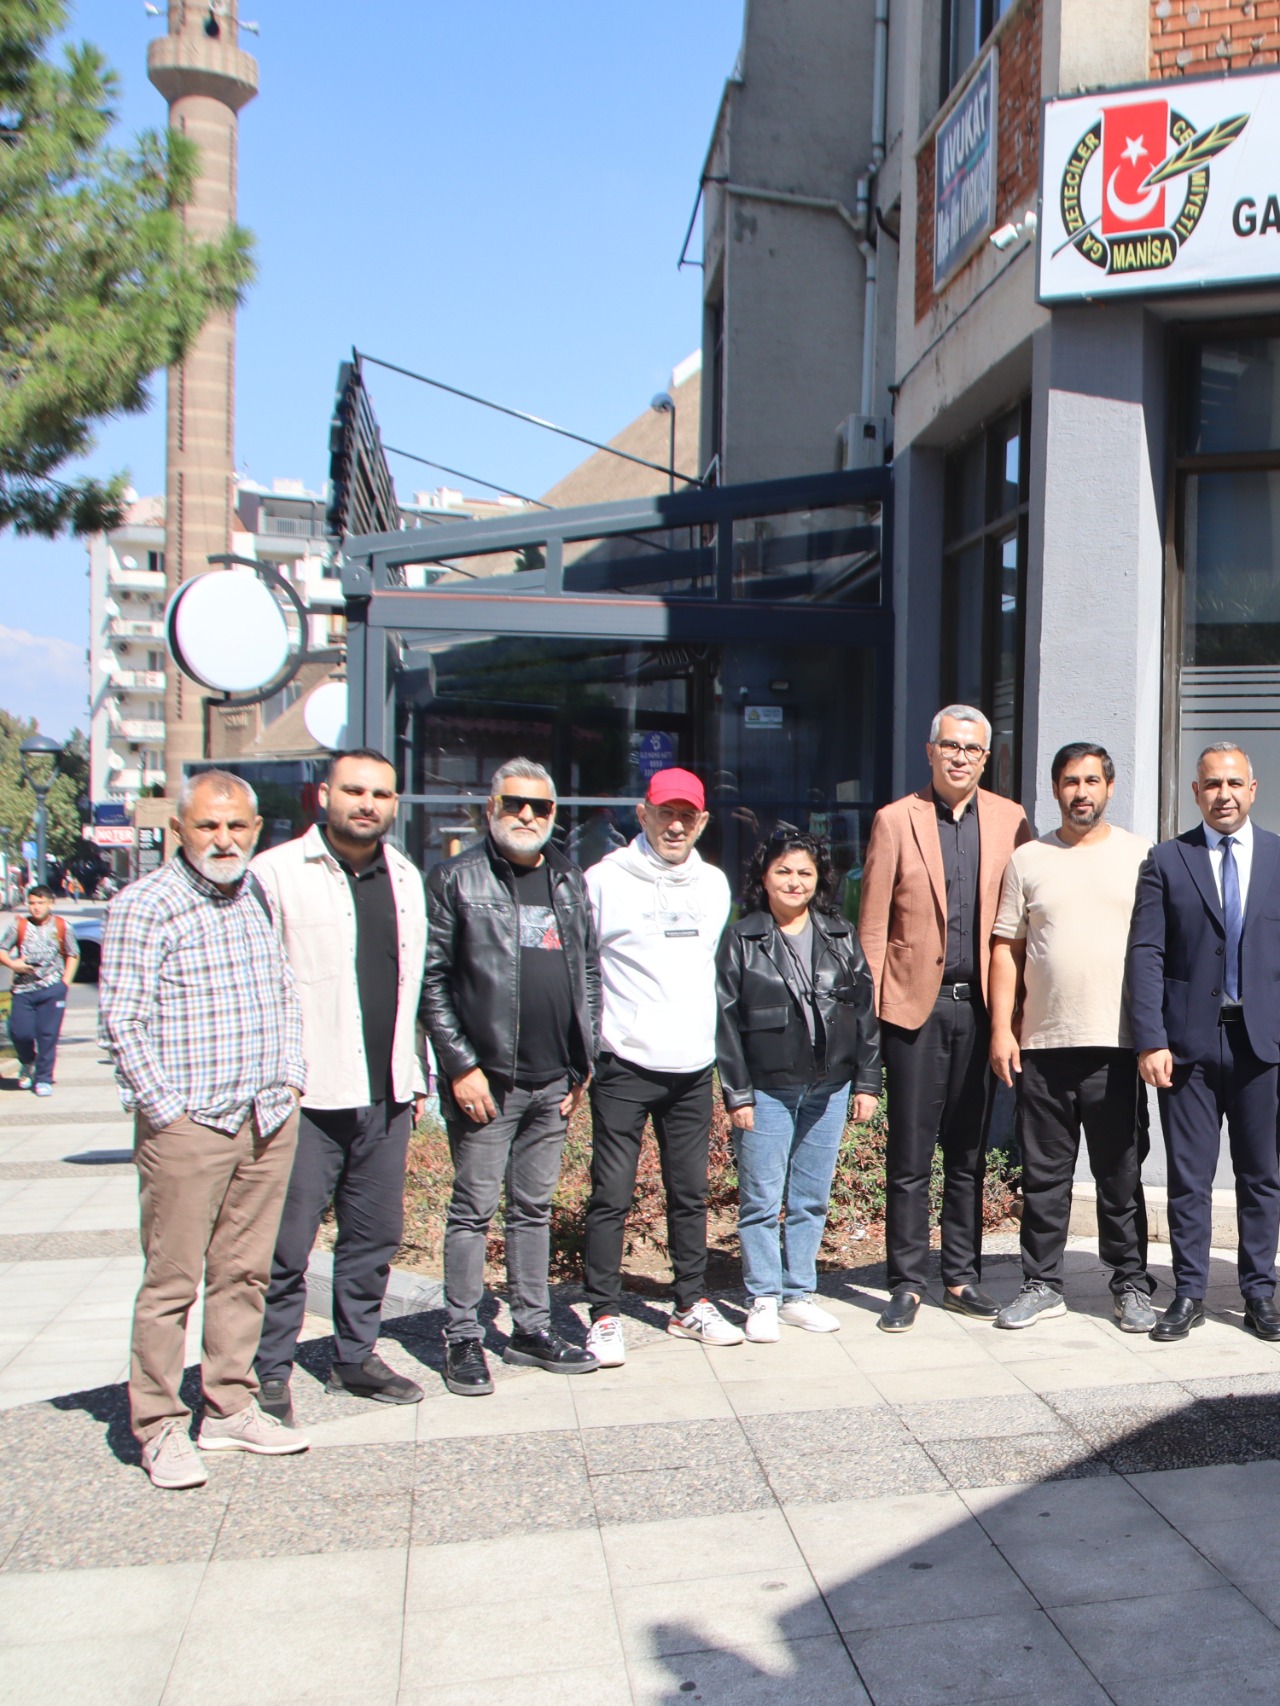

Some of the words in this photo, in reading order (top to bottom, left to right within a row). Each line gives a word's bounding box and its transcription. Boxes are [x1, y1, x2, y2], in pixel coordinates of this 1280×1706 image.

[943, 85, 988, 187] AVUKAT
[1113, 235, 1173, 270] MANİSA
[98, 829, 133, 841] NOTER
